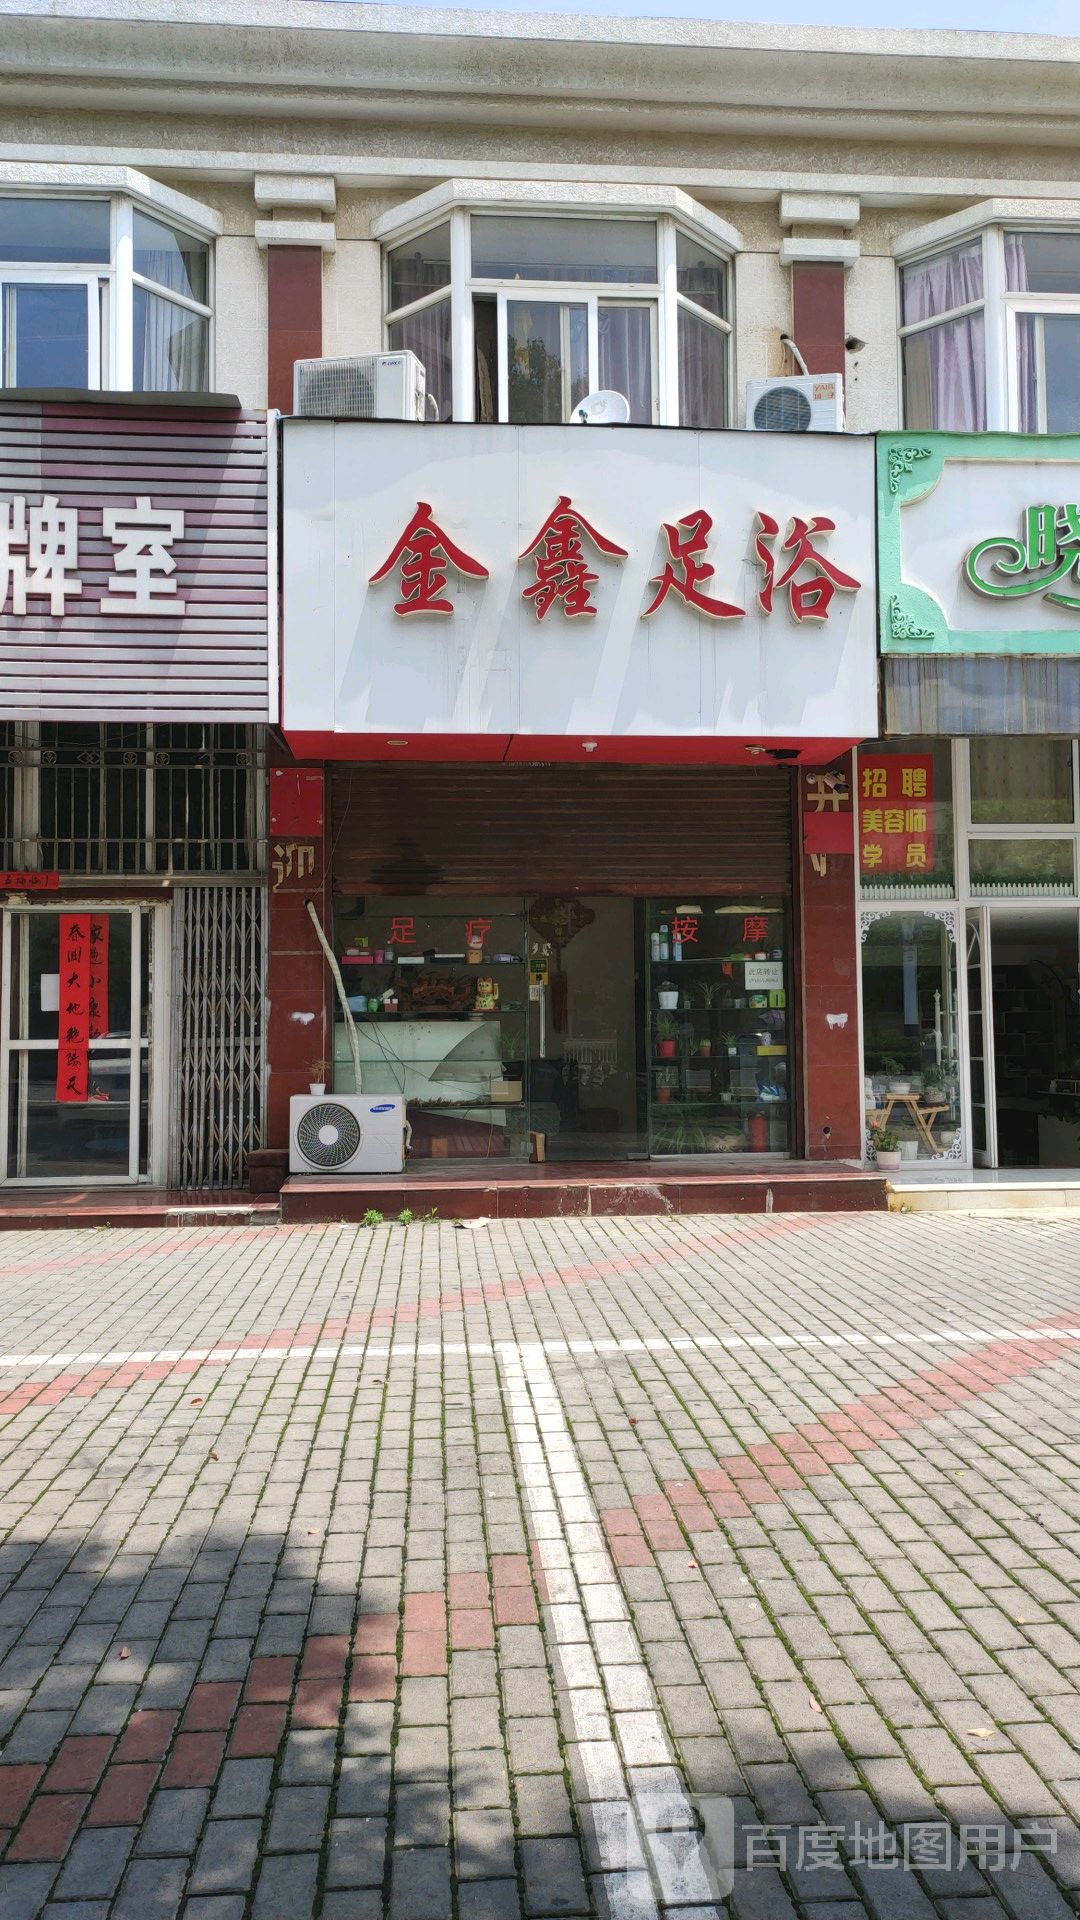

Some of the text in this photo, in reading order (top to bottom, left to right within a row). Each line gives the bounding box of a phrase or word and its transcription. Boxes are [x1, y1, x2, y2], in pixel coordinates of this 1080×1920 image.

[0, 495, 186, 616] 牌室
[368, 495, 862, 623] 金鑫足浴
[862, 768, 928, 799] 招聘
[862, 808, 928, 834] 美容师
[862, 843, 927, 869] 学员
[387, 916, 493, 945] 足疗
[671, 915, 769, 944] 按摩
